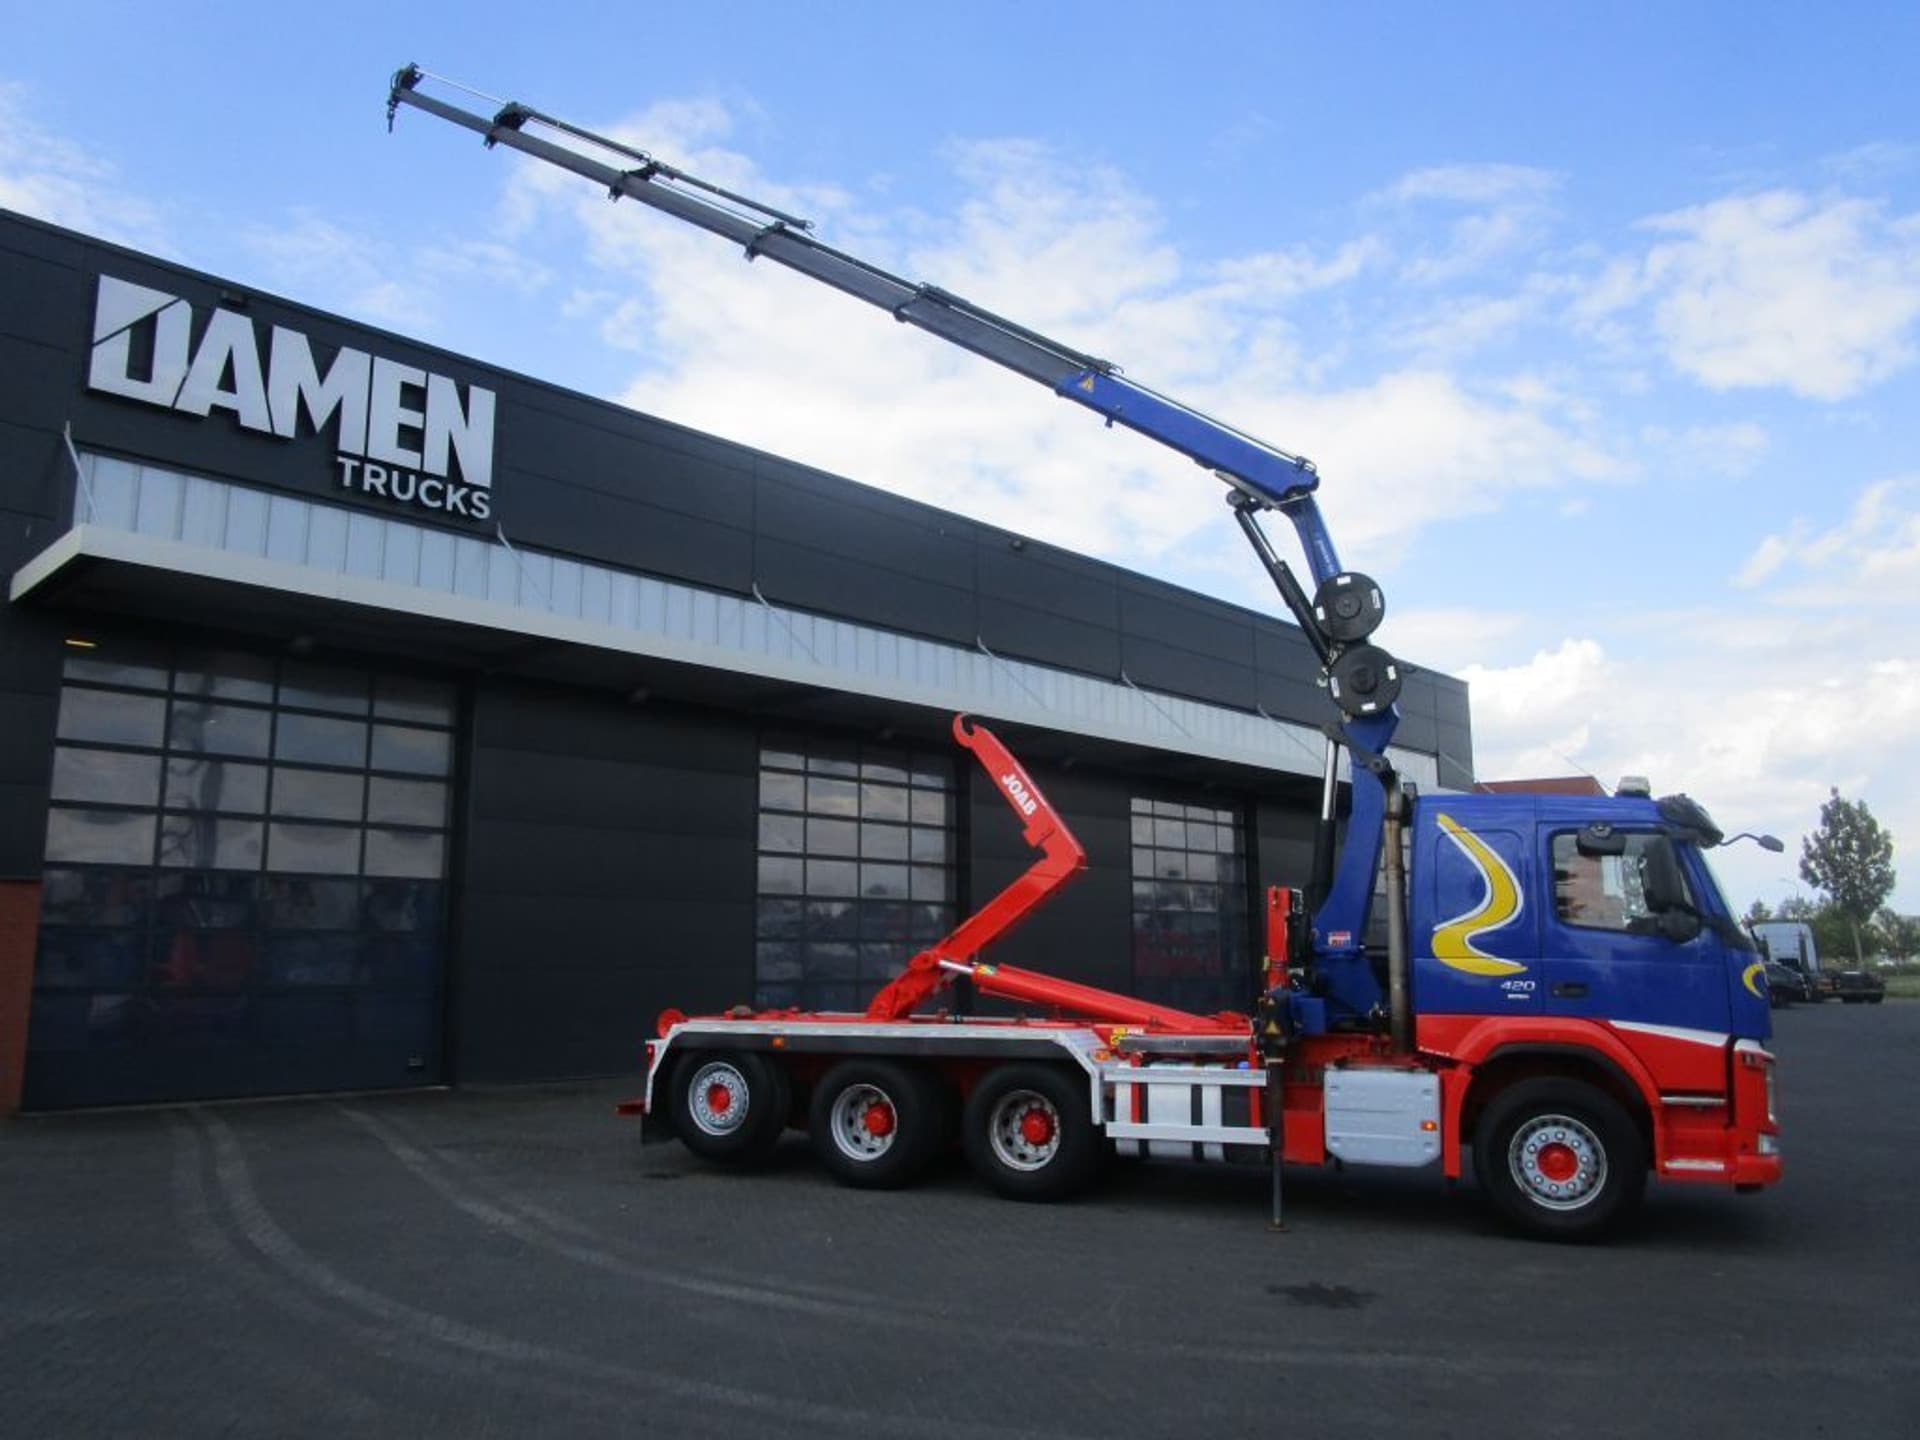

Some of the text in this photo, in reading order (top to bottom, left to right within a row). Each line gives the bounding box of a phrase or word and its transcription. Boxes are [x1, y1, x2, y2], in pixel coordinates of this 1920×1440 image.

[88, 274, 496, 488] DAMEN
[337, 456, 490, 519] TRUCKS
[1002, 774, 1037, 815] JOAB
[1500, 980, 1535, 991] 420
